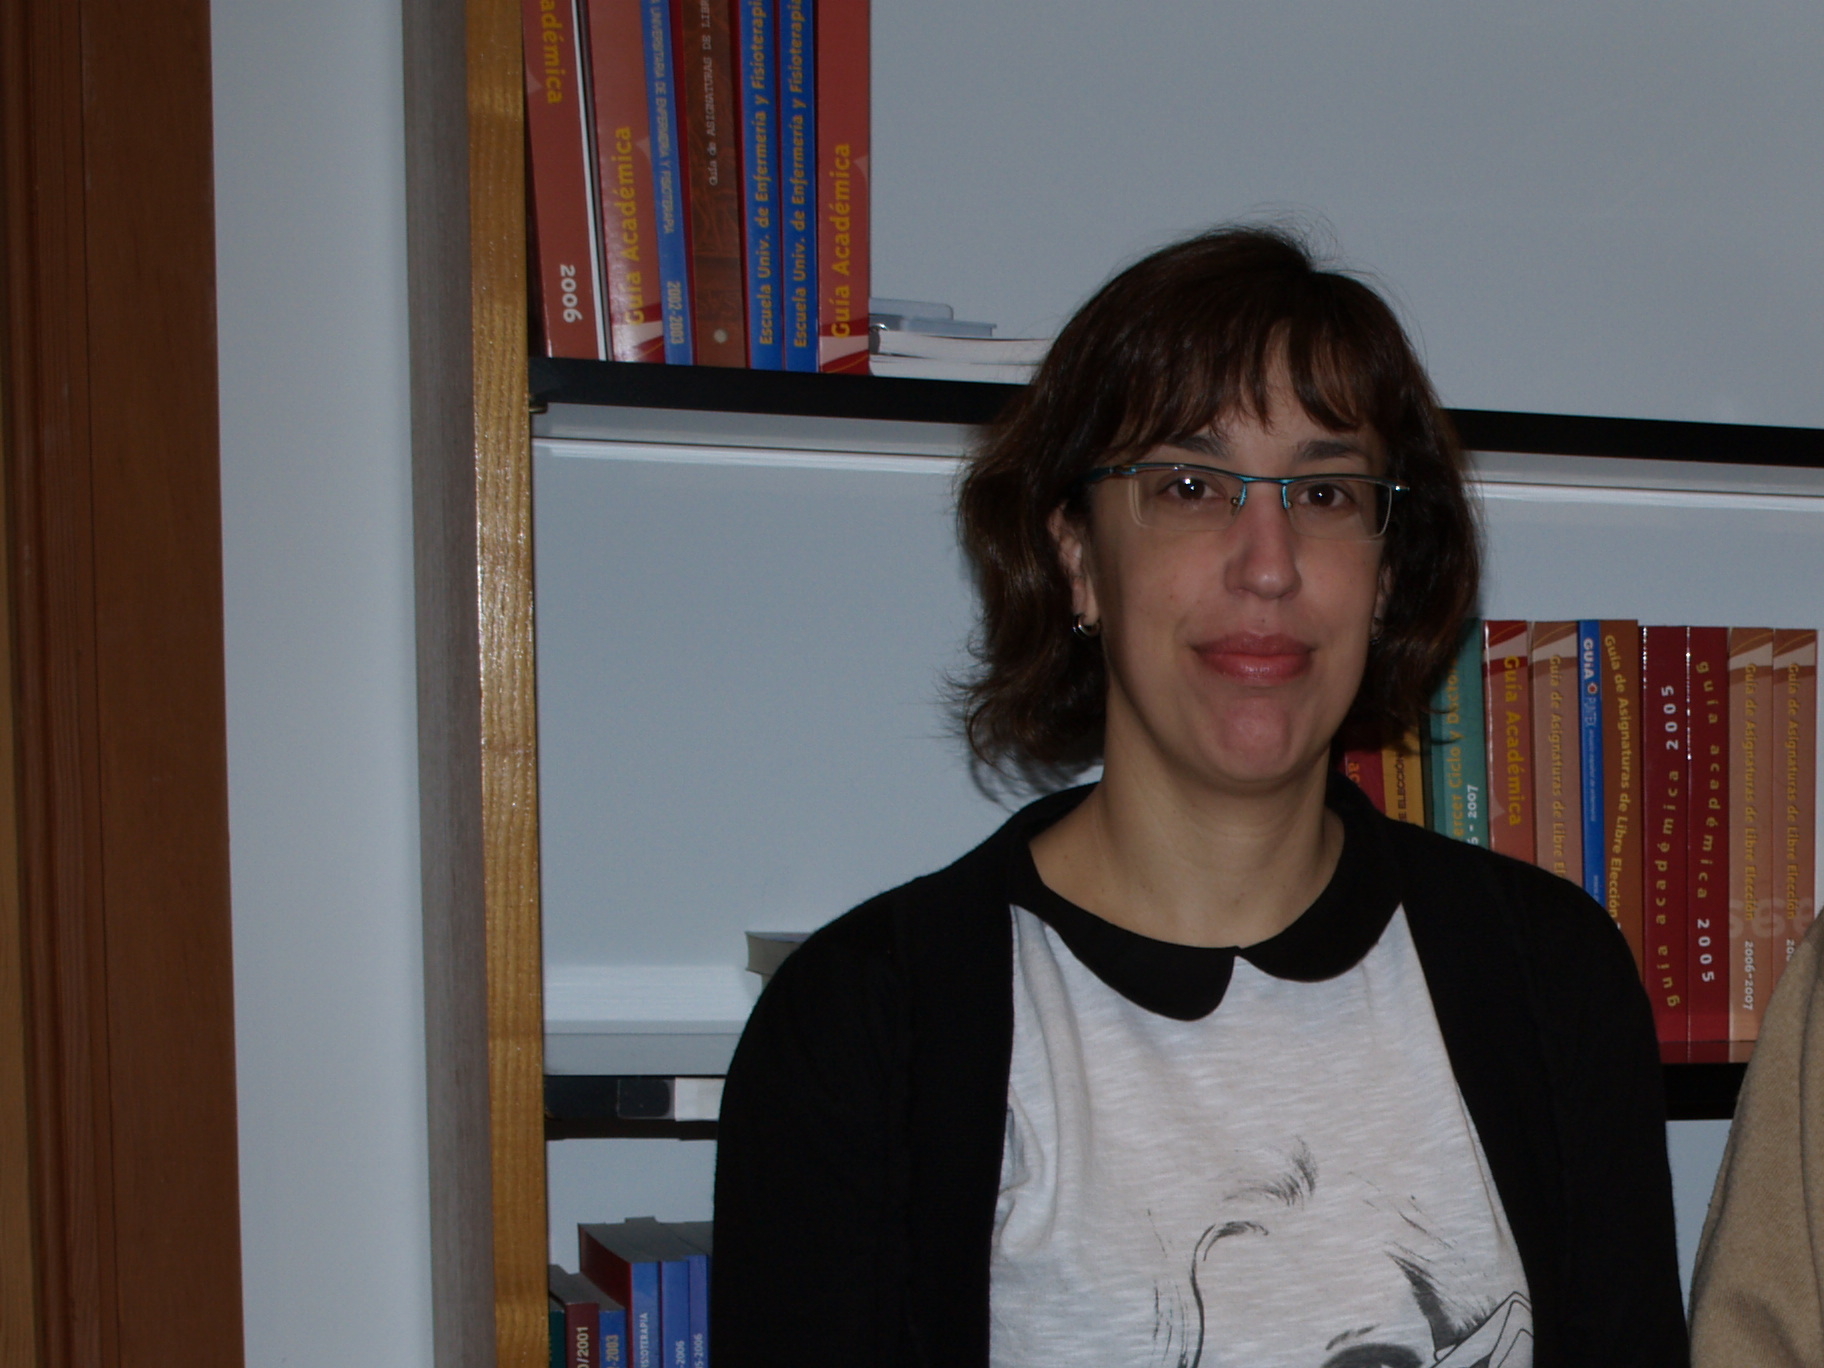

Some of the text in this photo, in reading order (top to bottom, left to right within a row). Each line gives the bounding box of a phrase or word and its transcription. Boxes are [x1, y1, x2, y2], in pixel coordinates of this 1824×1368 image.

[700, 0, 711, 28] LIBR
[702, 35, 712, 50] DE
[703, 56, 716, 137] ASIGNATURAS
[792, 97, 807, 108] y
[541, 0, 583, 324] adémica 2006
[706, 141, 717, 156] de
[788, 114, 809, 205] Enfermería
[748, 0, 774, 345] Escuela Univ. de Enfermería y Fisioterapi
[611, 126, 645, 326] Guía Académica
[790, 210, 806, 231] de
[829, 143, 851, 339] Guía Académica
[792, 237, 807, 282] Univ.
[667, 280, 684, 345] 2002-2003
[792, 287, 808, 348] Escuela
[1550, 655, 1562, 687] Guía
[1604, 634, 1621, 671] Guía
[1550, 691, 1563, 709] de
[1614, 673, 1627, 693] de
[1503, 656, 1526, 827] Guía Académica
[1548, 714, 1564, 797] Asignaturas
[1617, 697, 1632, 789] Asignaturas
[1446, 746, 1463, 788] Ciclo
[1467, 784, 1479, 819] 2007
[1553, 801, 1566, 818] de
[1618, 793, 1631, 812] de
[1785, 663, 1800, 920] Guía de Asignaturas de Libre Elección
[1453, 794, 1464, 838] ercer
[1612, 816, 1629, 854] Libre
[1696, 660, 1721, 983] guía académica 2005
[1742, 663, 1759, 1011] Guía de Asignaturas de Libre Elección 2006-2007
[1553, 822, 1566, 857] Libre
[1654, 684, 1681, 1008] guía académica 2005
[1608, 857, 1622, 918] Elección
